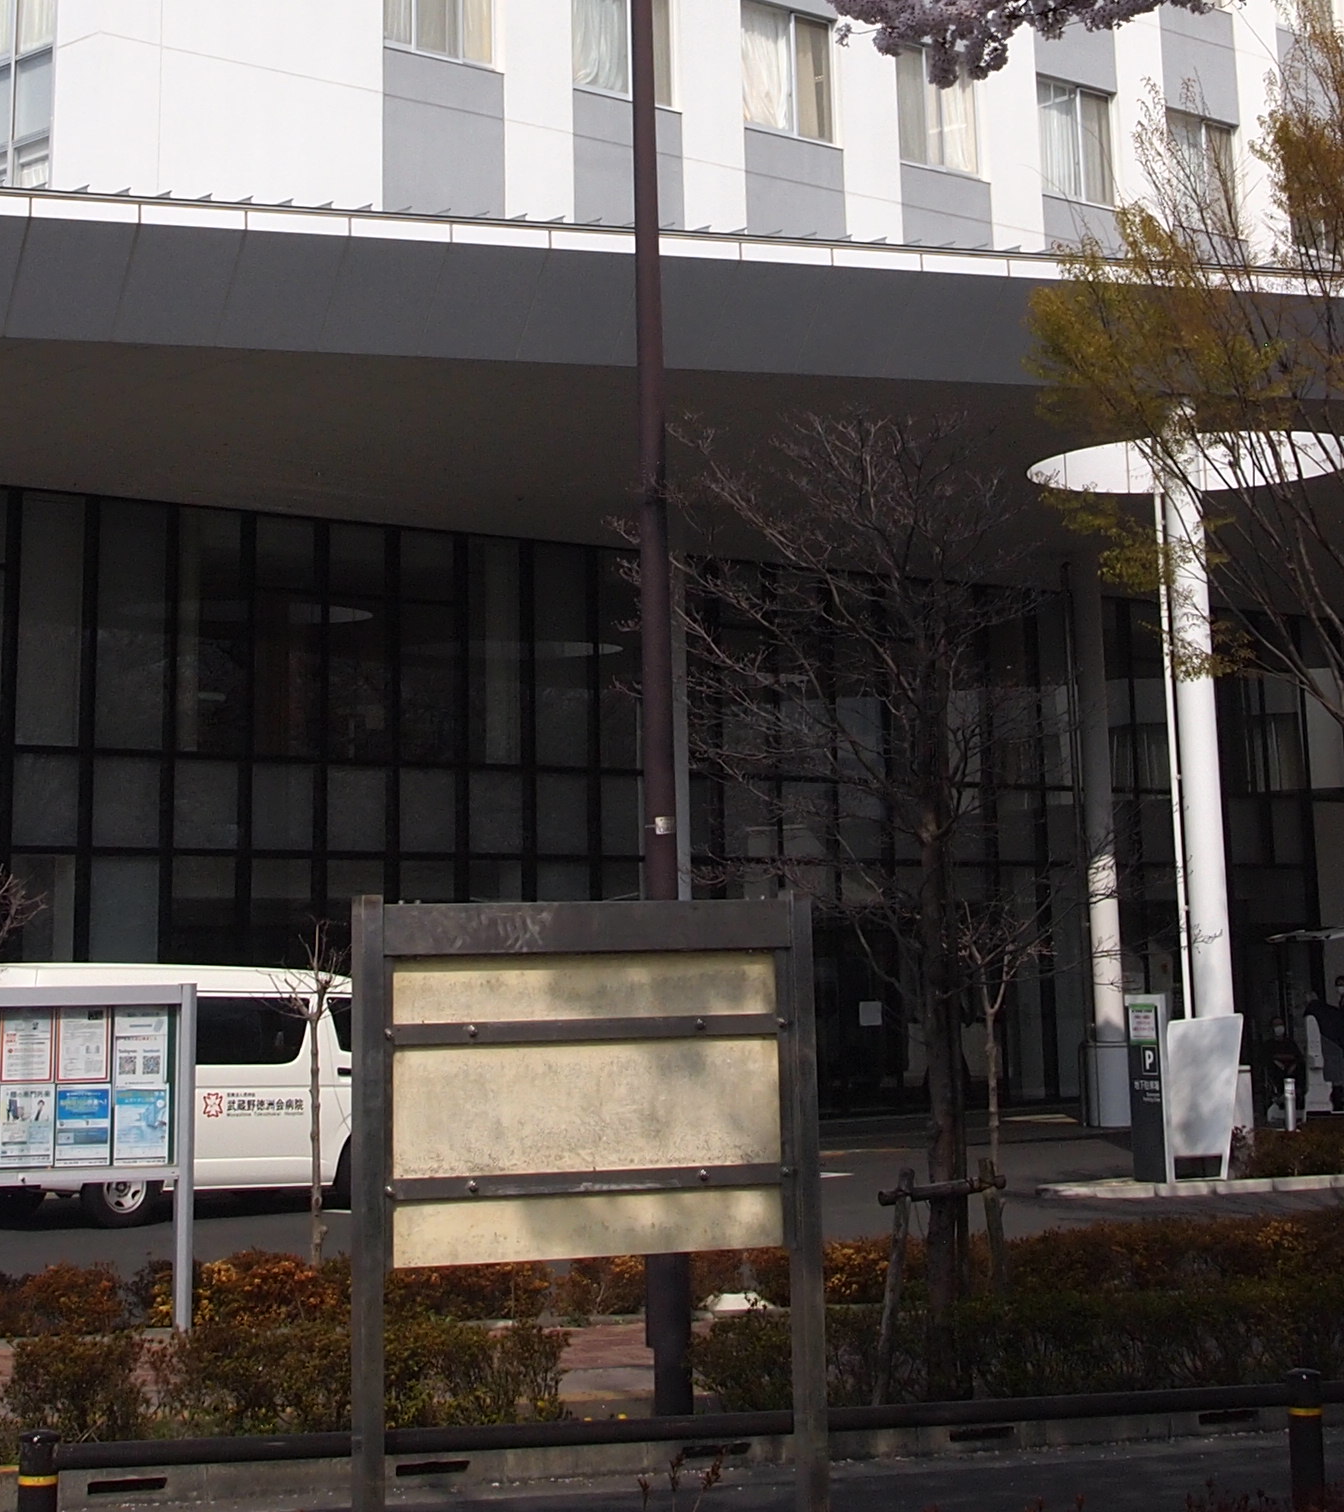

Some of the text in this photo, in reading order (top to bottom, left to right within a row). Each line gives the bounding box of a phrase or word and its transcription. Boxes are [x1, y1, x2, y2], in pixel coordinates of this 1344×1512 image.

[1145, 1049, 1154, 1070] P
[227, 1098, 304, 1111] 武蔵野徳洲会病院
